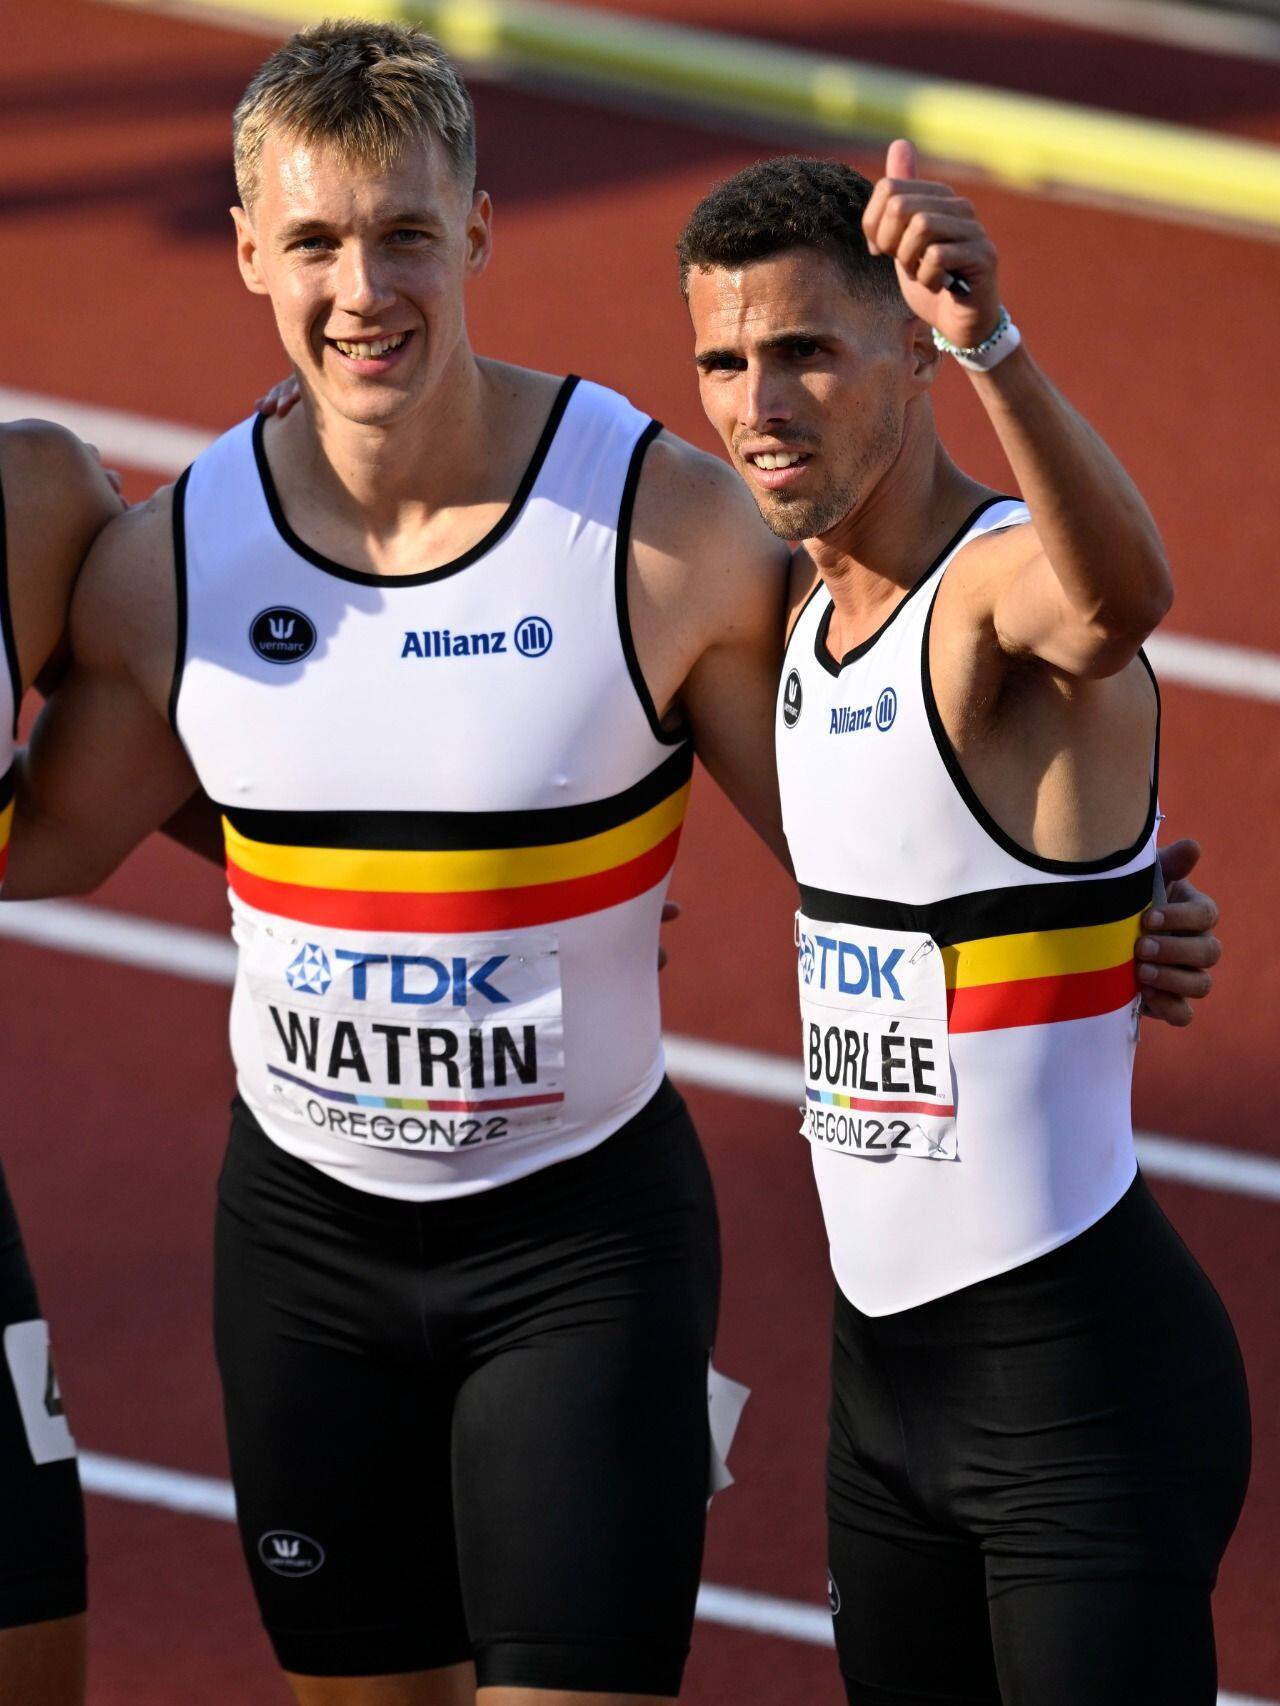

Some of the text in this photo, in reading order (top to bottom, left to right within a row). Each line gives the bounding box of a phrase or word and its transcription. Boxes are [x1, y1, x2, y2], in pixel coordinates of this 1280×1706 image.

[258, 639, 305, 652] vermarc
[401, 630, 507, 658] Allianz
[829, 705, 873, 734] Allianz
[335, 949, 511, 1006] TDK
[814, 935, 906, 1001] TDK
[269, 1005, 538, 1089] WATRIN
[809, 1021, 937, 1096] BORLÉE
[307, 1099, 509, 1147] OREGON22
